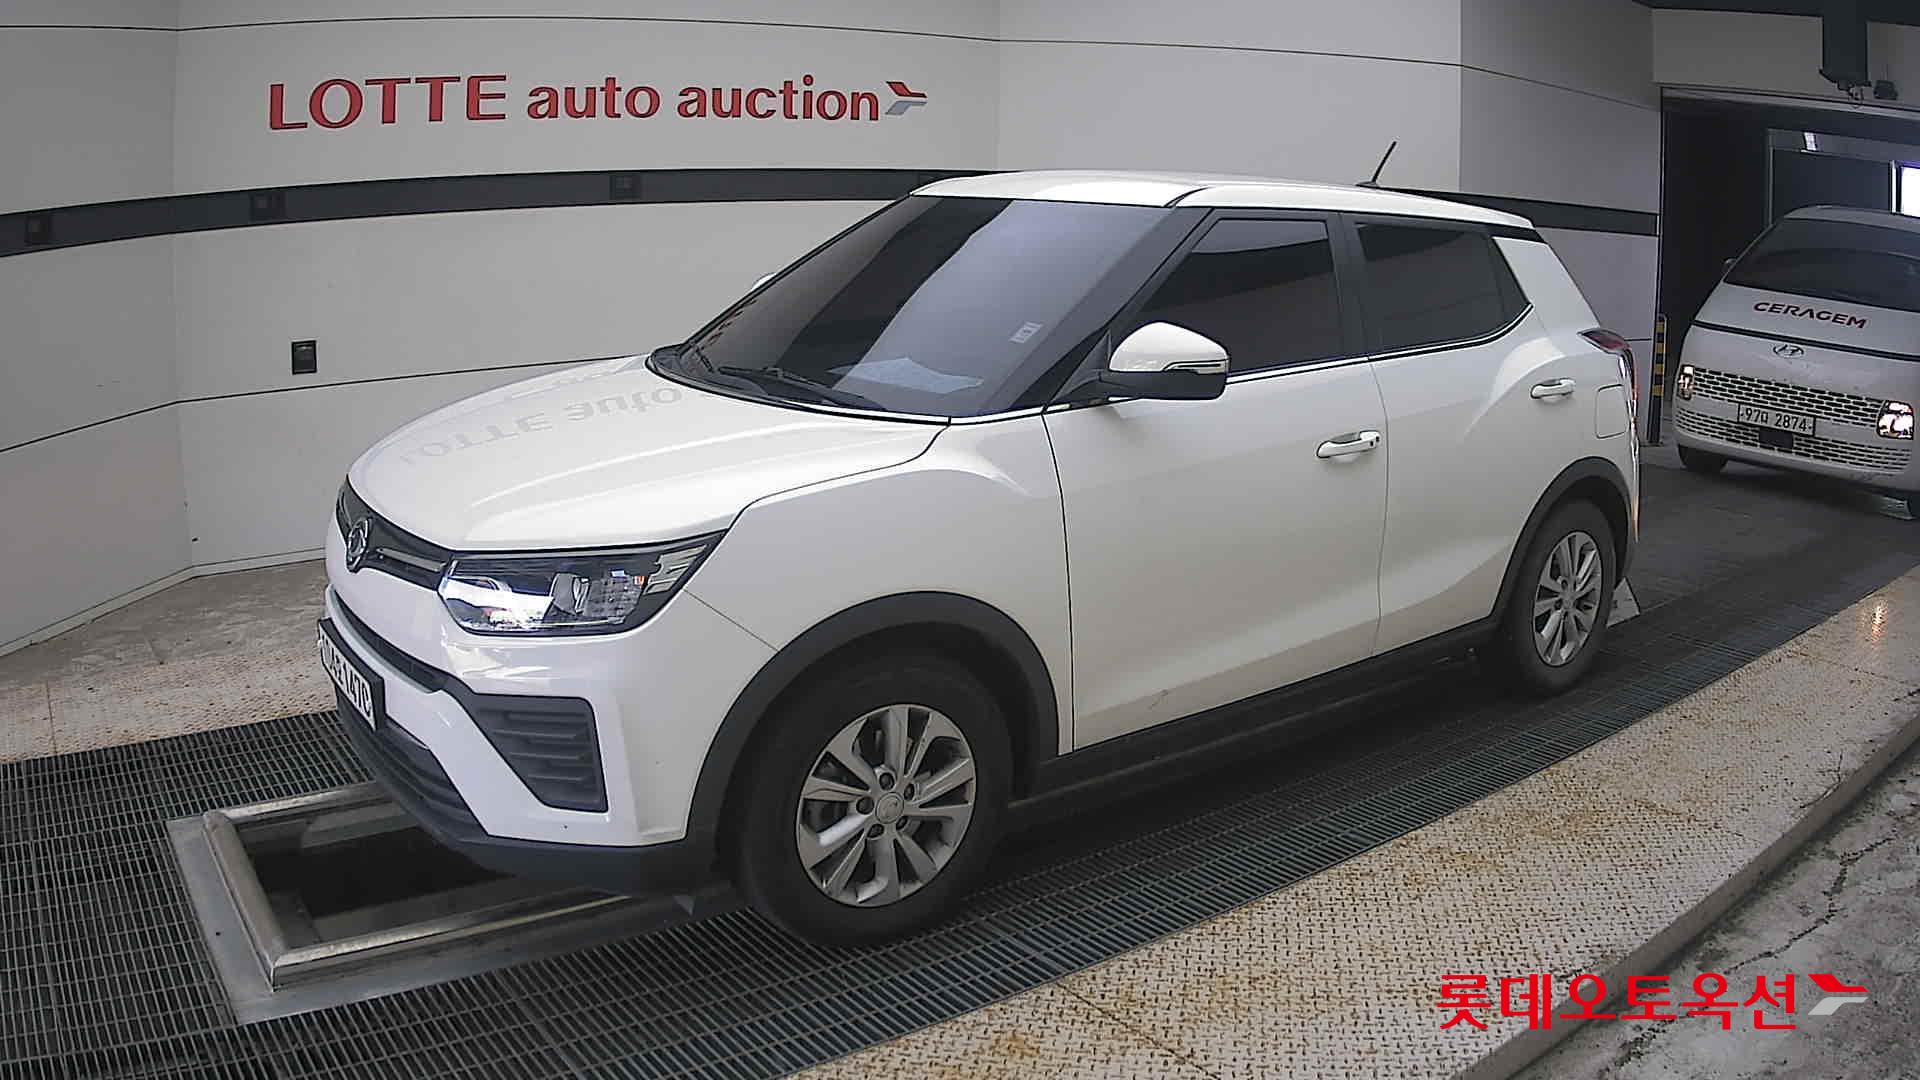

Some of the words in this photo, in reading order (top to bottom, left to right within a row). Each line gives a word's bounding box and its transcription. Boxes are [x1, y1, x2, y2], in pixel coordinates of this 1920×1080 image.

[270, 75, 507, 130] LOTTE
[527, 77, 661, 120] auto
[678, 75, 880, 121] auction
[1753, 301, 1867, 329] CERAGEM
[1774, 412, 1807, 432] 2874
